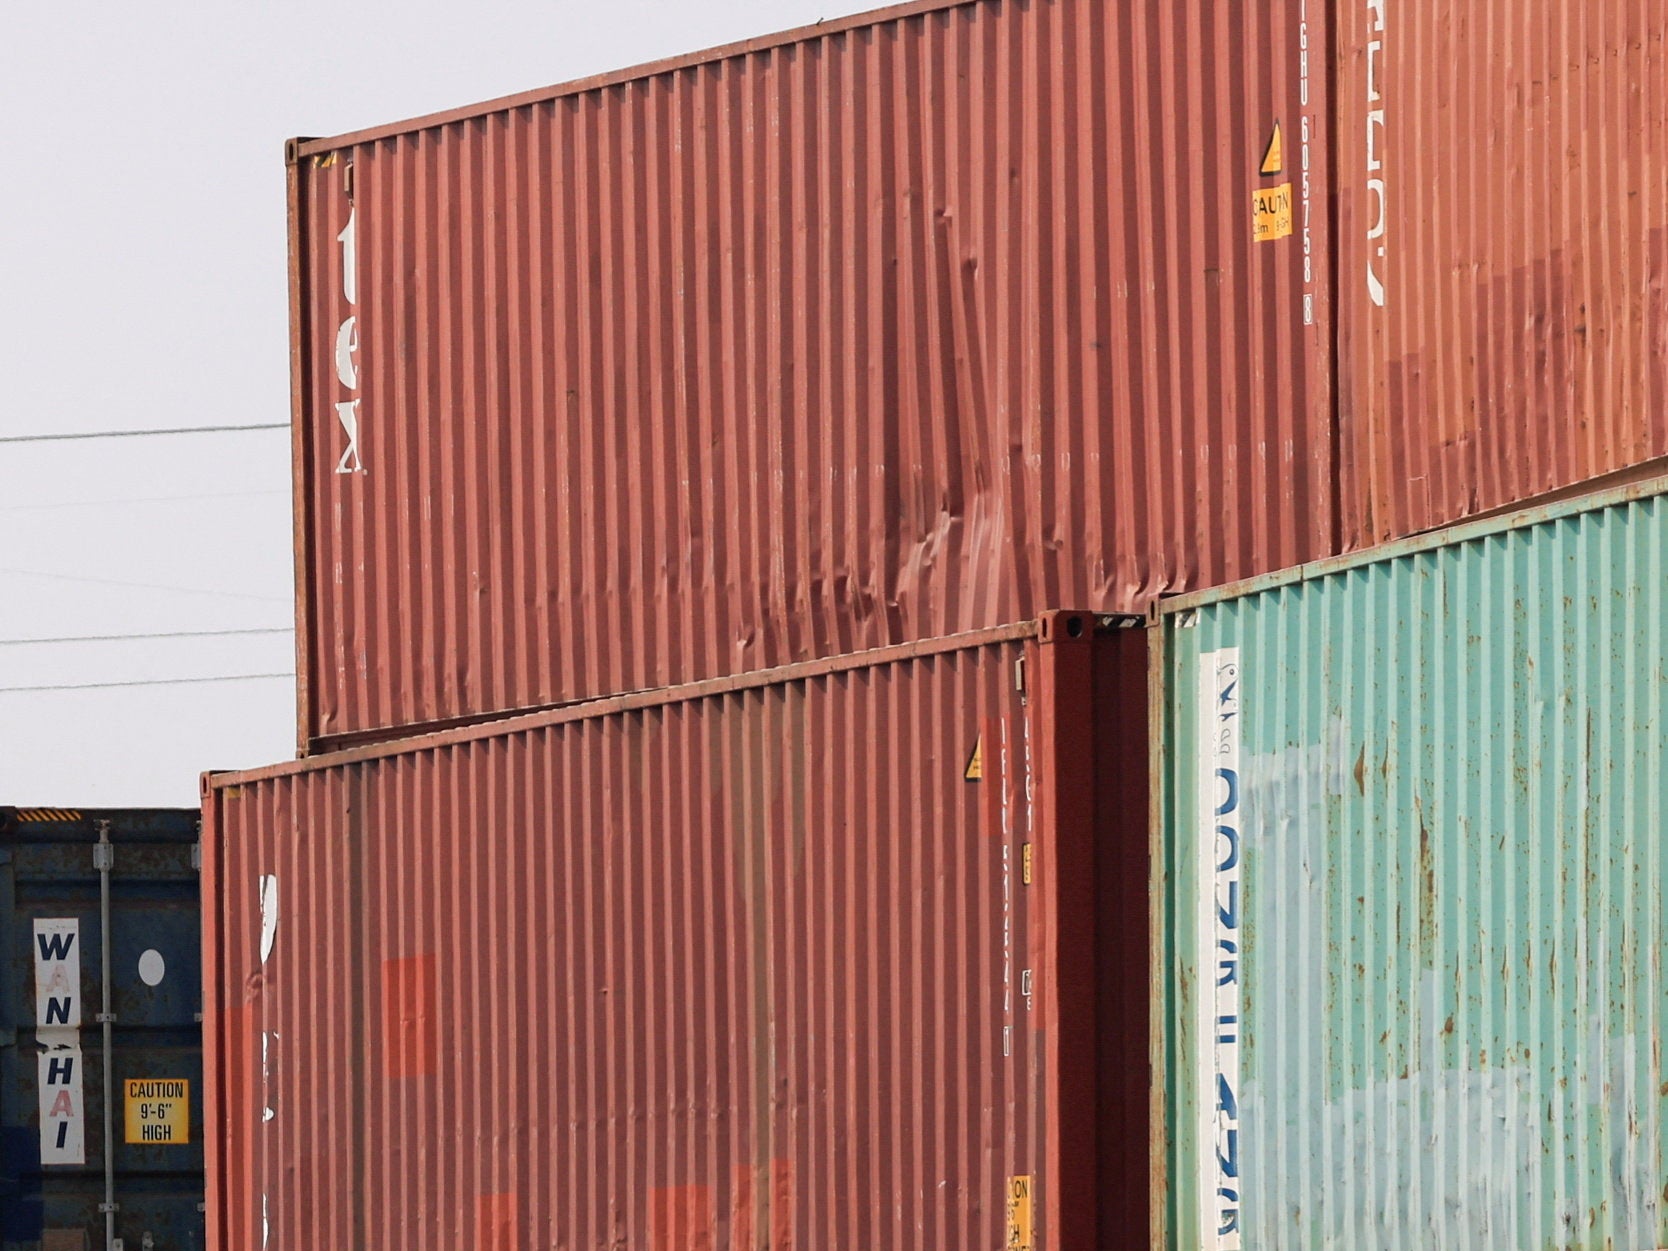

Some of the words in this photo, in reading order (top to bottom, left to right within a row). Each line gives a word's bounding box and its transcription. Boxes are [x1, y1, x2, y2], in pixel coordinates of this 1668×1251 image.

[37, 933, 75, 1024] WAN
[47, 1057, 74, 1149] HAI
[129, 1082, 184, 1099] CAUTION
[142, 1125, 171, 1141] HIGH
